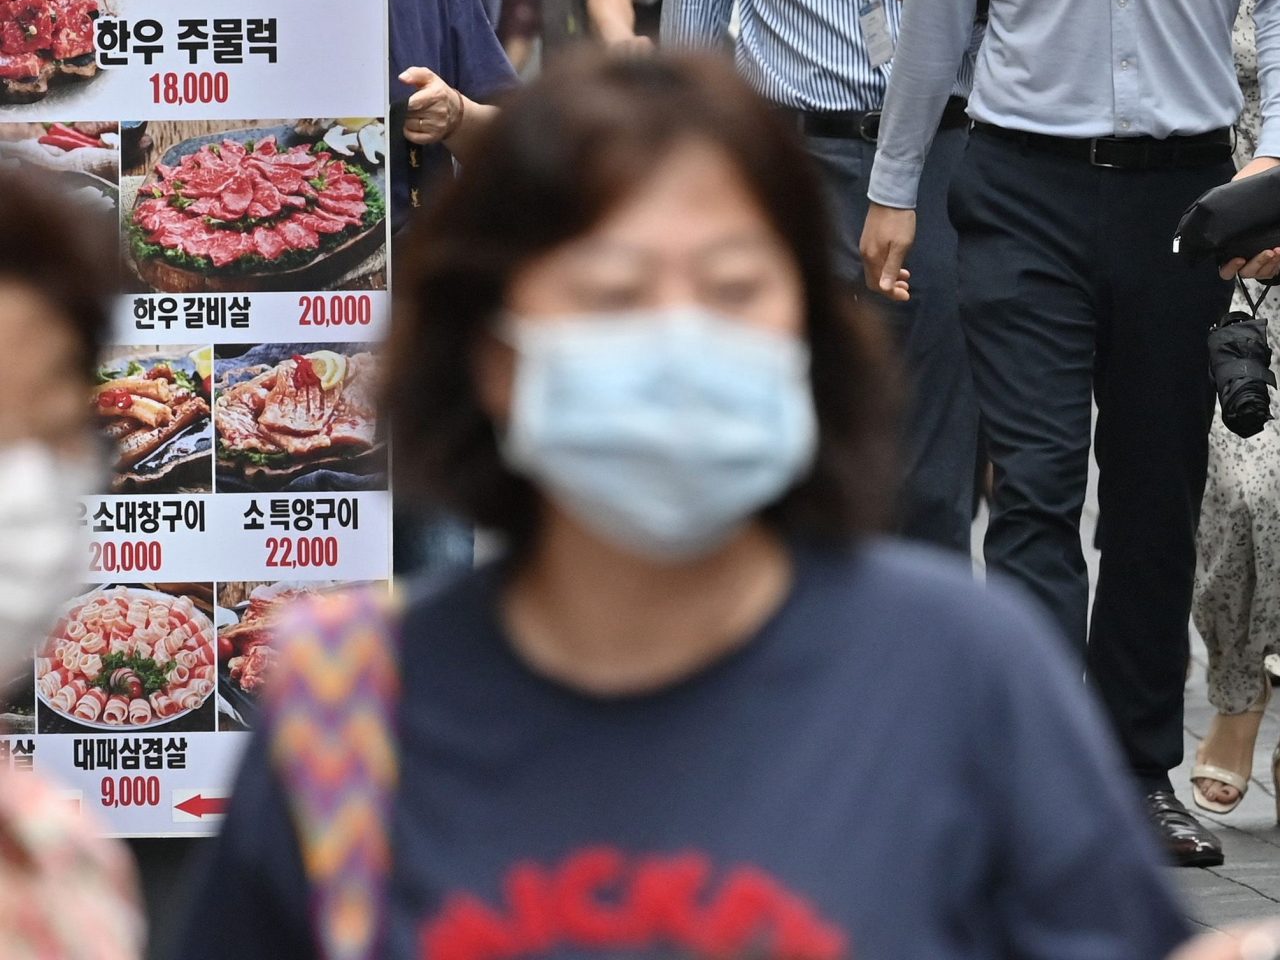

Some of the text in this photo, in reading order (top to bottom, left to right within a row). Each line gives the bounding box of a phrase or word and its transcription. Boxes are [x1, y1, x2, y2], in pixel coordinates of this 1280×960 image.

[97, 18, 278, 66] 한우 주물럭
[150, 72, 229, 105] 18,000
[133, 295, 371, 330] 한우 갈비살 20,000
[92, 500, 205, 533] 소대창구이
[88, 541, 162, 573] 20,000
[265, 536, 338, 569] 22,000
[0, 739, 35, 772] 살
[73, 737, 187, 770] 대패삼겹살
[101, 776, 160, 808] 9,000
